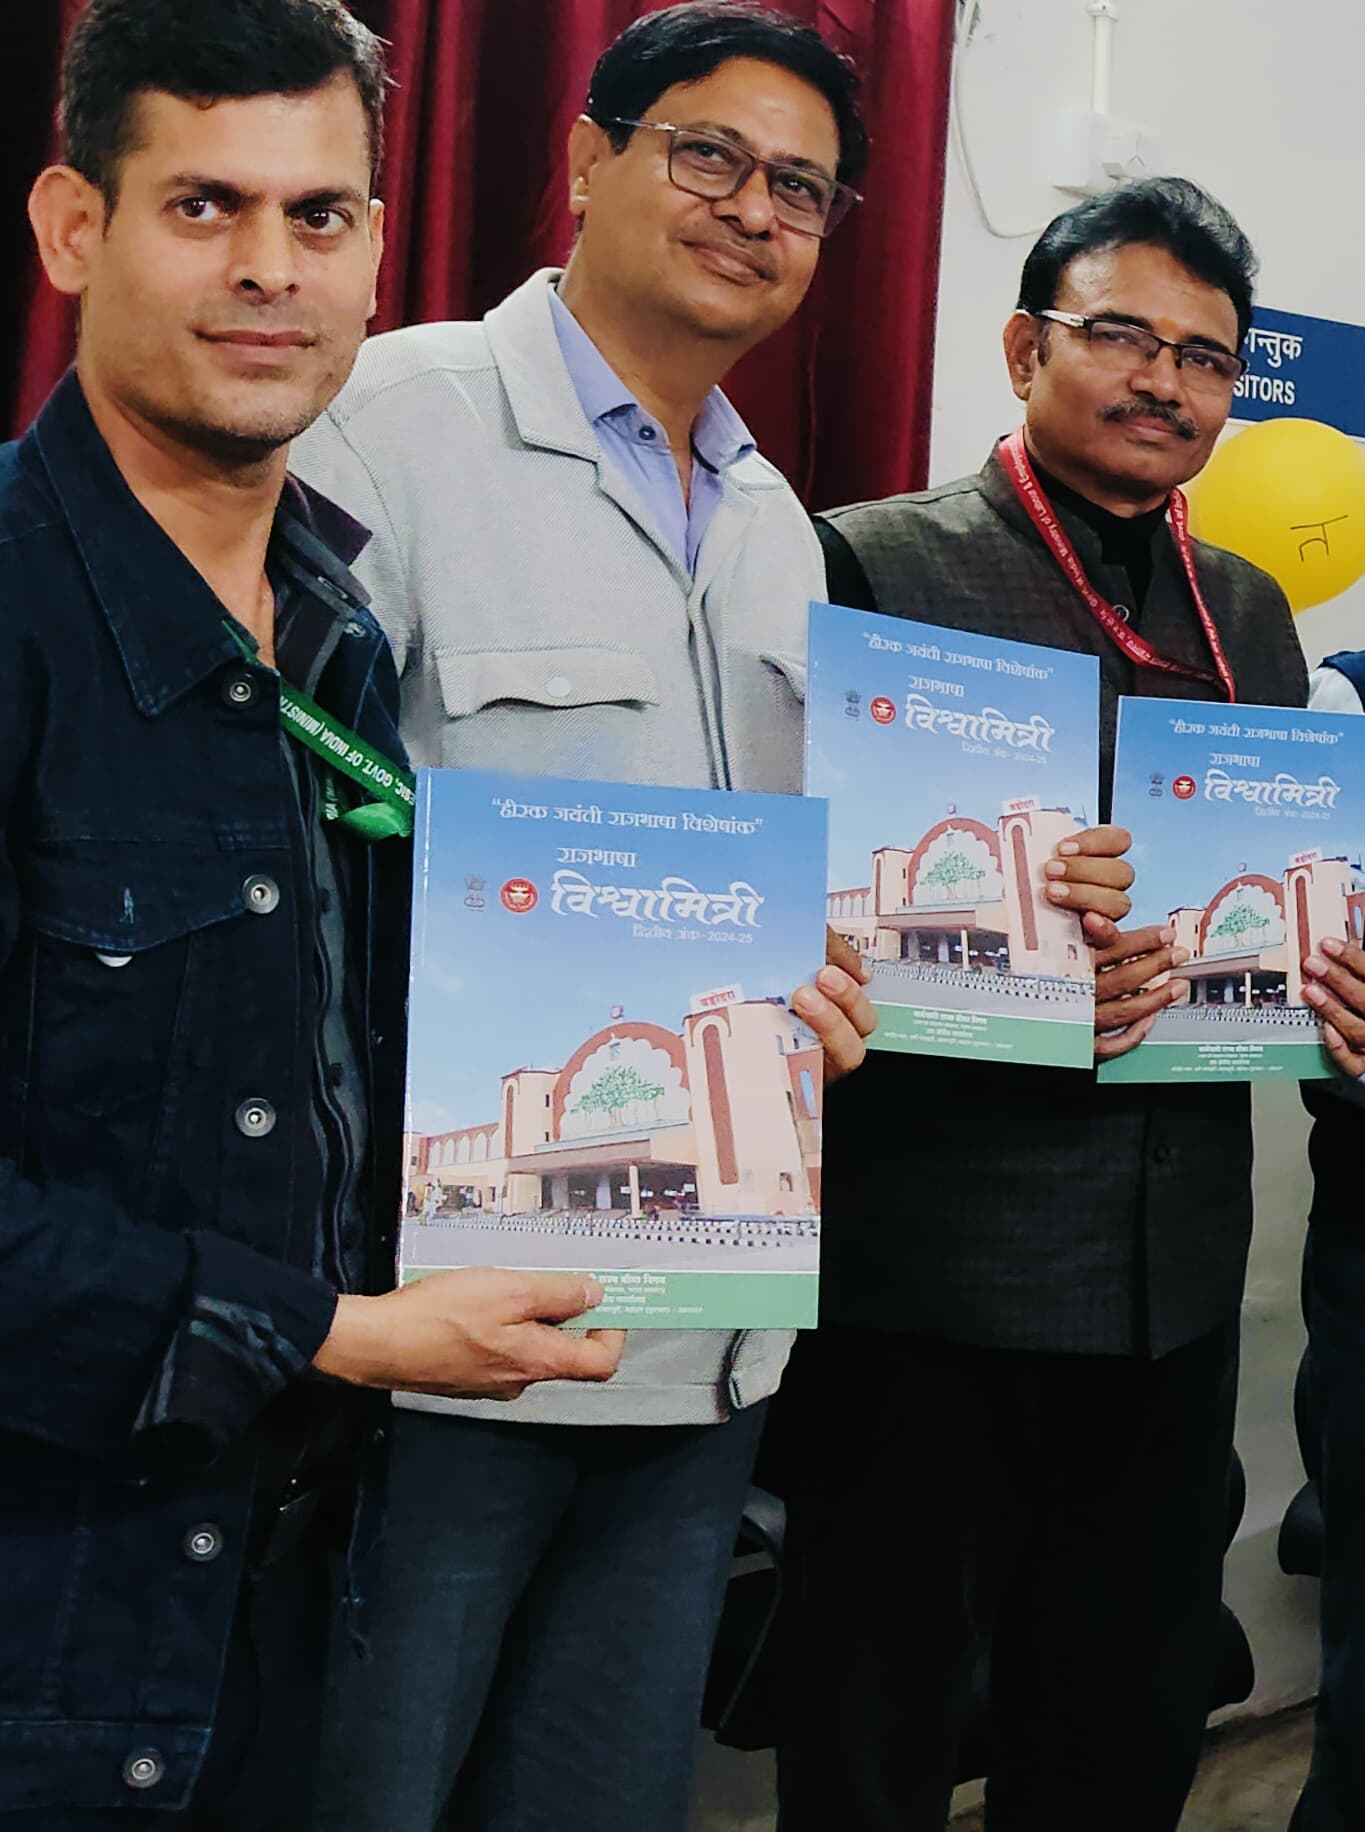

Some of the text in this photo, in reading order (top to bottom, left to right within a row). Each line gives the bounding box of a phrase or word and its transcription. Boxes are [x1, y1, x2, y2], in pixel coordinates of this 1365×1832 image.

[1233, 373, 1295, 405] SITORS
[905, 693, 1055, 752] विश्वामित्री
[1204, 769, 1341, 808] विश्वामित्री
[607, 811, 676, 830] राजभाषा
[557, 847, 637, 868] राजभाषा
[550, 870, 765, 928] विश्वामित्री
